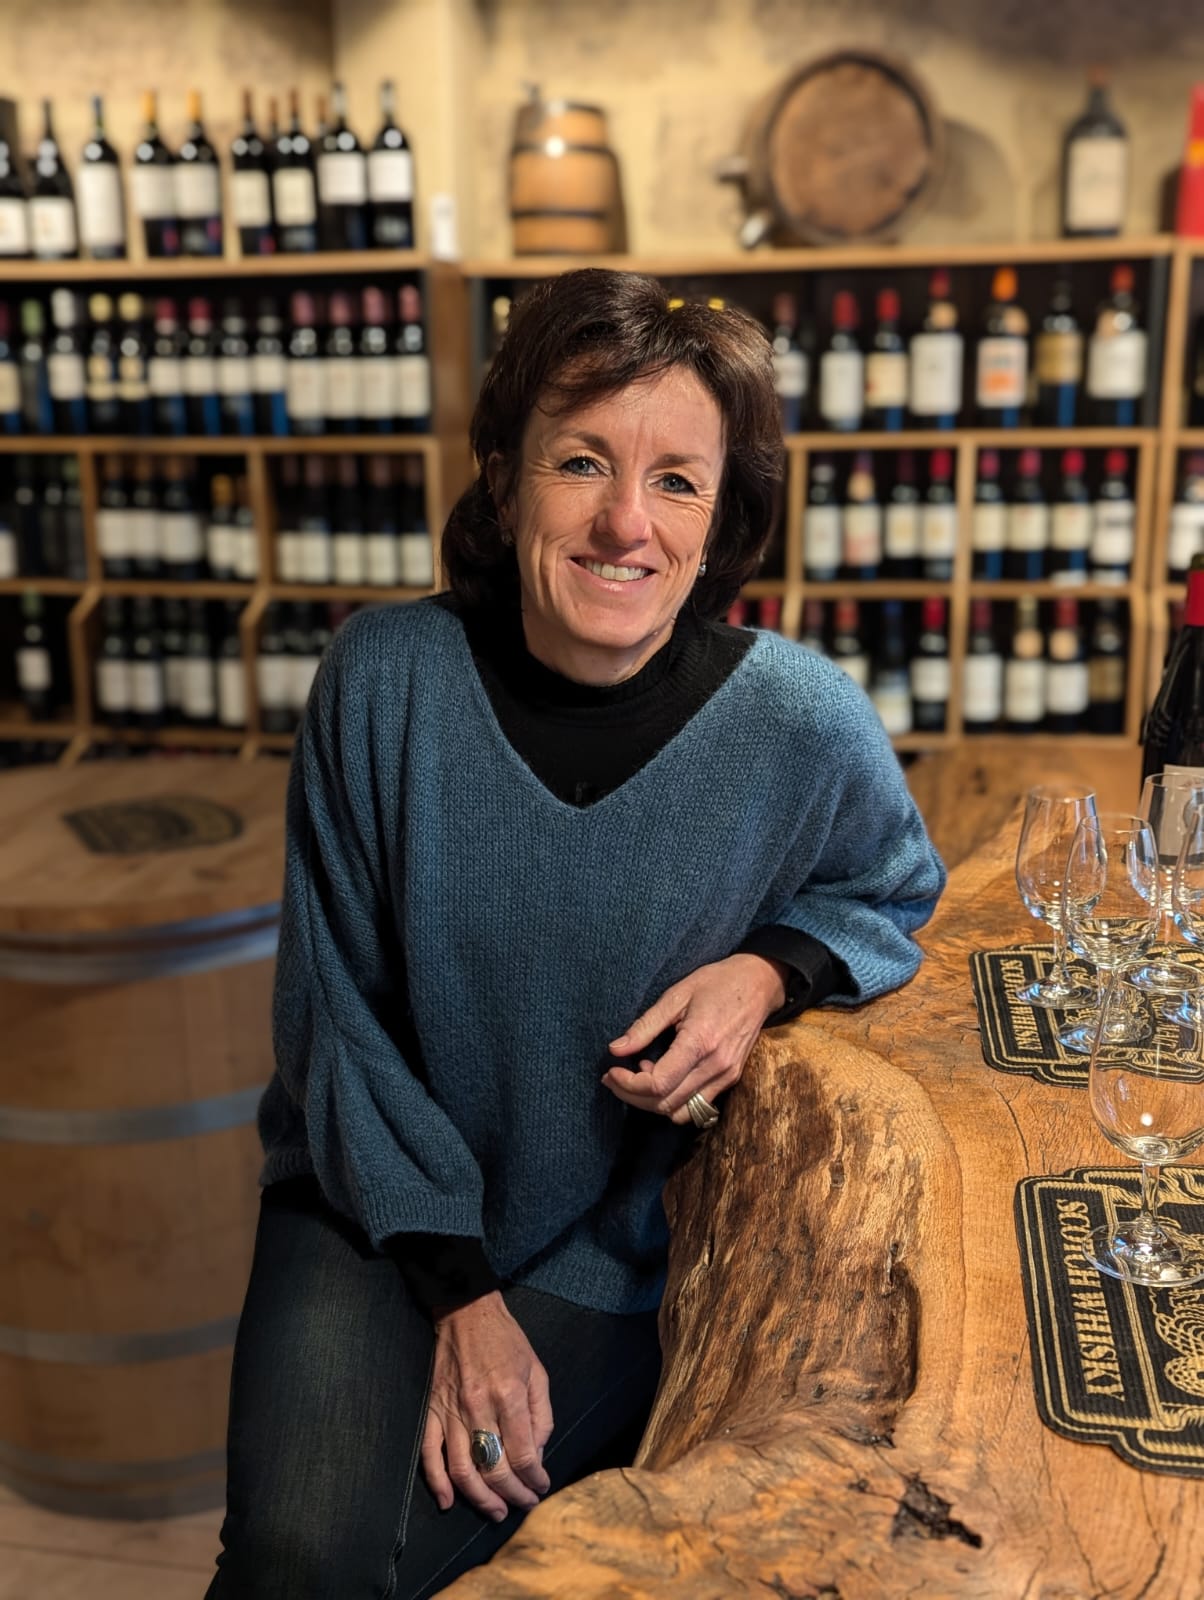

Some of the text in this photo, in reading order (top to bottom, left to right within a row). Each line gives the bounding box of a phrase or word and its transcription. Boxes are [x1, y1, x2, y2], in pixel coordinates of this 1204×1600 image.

[1009, 1006, 1043, 1053] WHISKY
[1056, 1198, 1125, 1401] SCOTCH WHISKY
